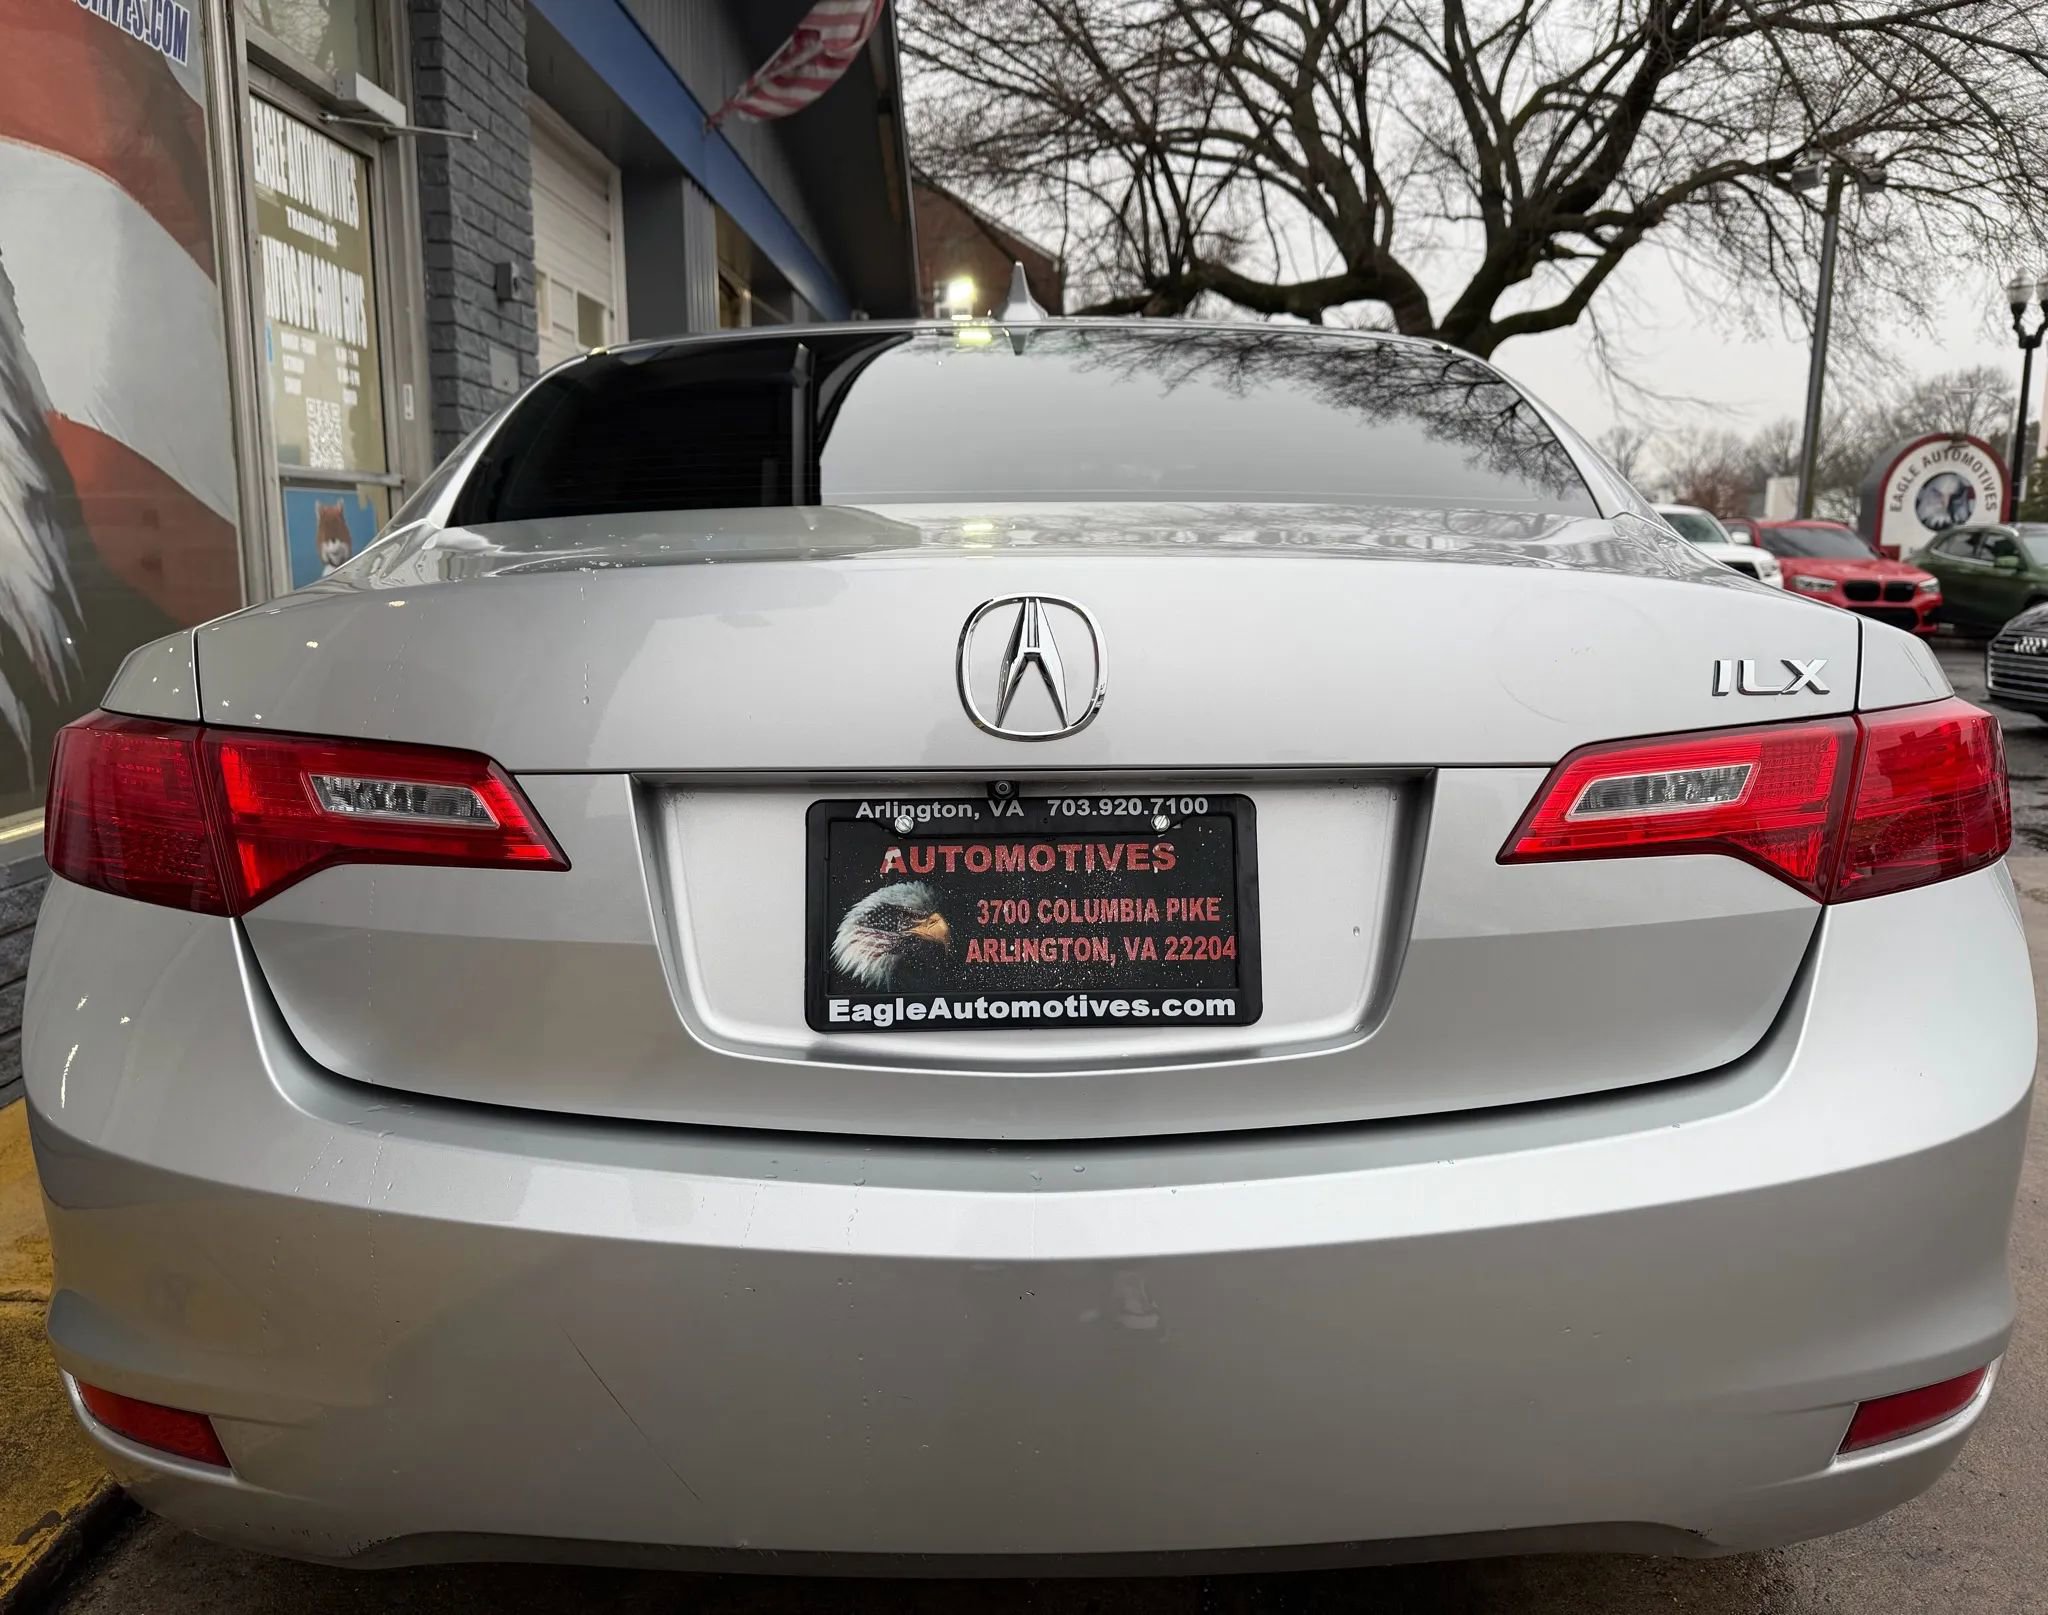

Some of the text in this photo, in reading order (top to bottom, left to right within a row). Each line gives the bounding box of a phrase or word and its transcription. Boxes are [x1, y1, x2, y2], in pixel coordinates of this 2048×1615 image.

[249, 95, 360, 231] EAGLE AUTOMOTIVES
[286, 205, 325, 242] TRADING
[1889, 448, 1998, 513] EAGLE AUTOMOTIVES
[1712, 658, 1830, 696] ILX
[856, 797, 1208, 821] Arlington, VA 703.920.7100
[880, 843, 1177, 874] AUTOMOTIVES
[976, 897, 1221, 924] 3700 COLUMBIA PIKE
[966, 935, 1238, 965] ARLINGTON, VA 22204
[829, 995, 1236, 1027] EagleAutomotives.com
